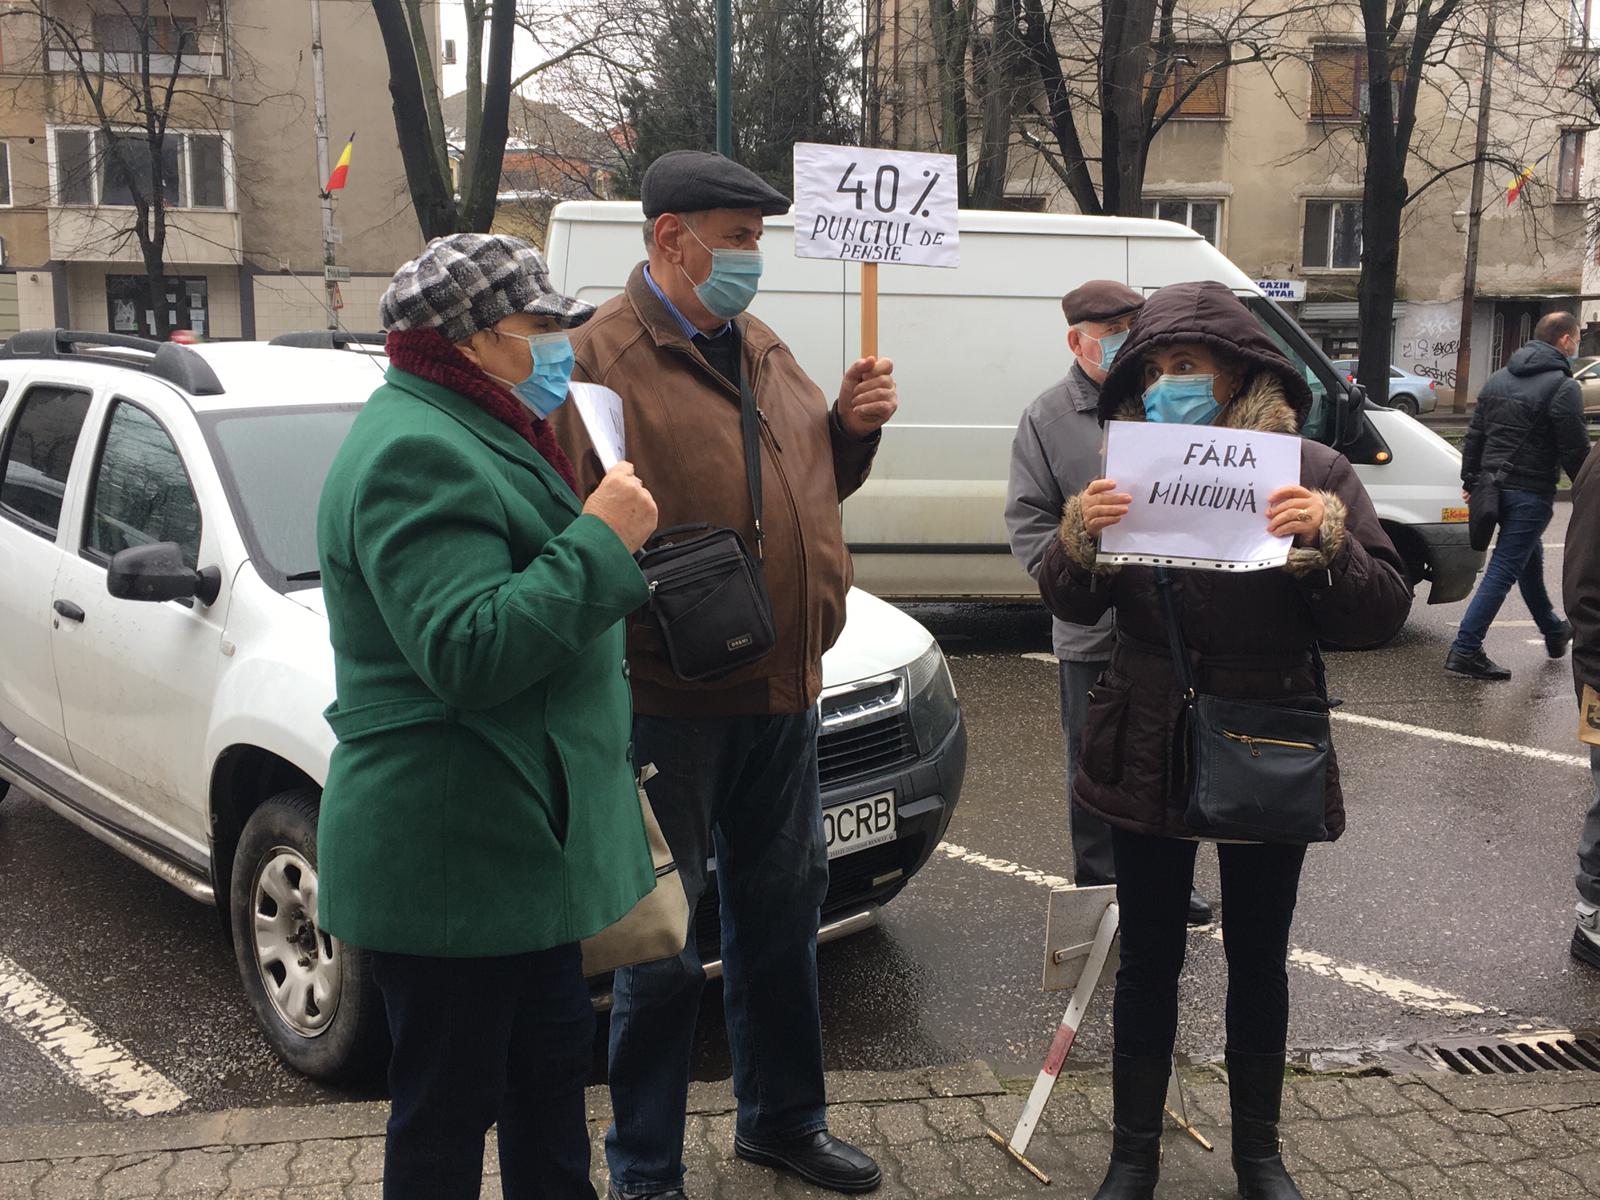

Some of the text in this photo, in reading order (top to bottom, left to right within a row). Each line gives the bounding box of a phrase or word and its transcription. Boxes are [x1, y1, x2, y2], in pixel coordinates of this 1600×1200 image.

[836, 162, 941, 218] 40%
[810, 214, 945, 246] PUNCTUL DE
[839, 243, 902, 261] PENSIE
[1256, 281, 1290, 289] GAZIN
[1265, 290, 1295, 298] NTAR
